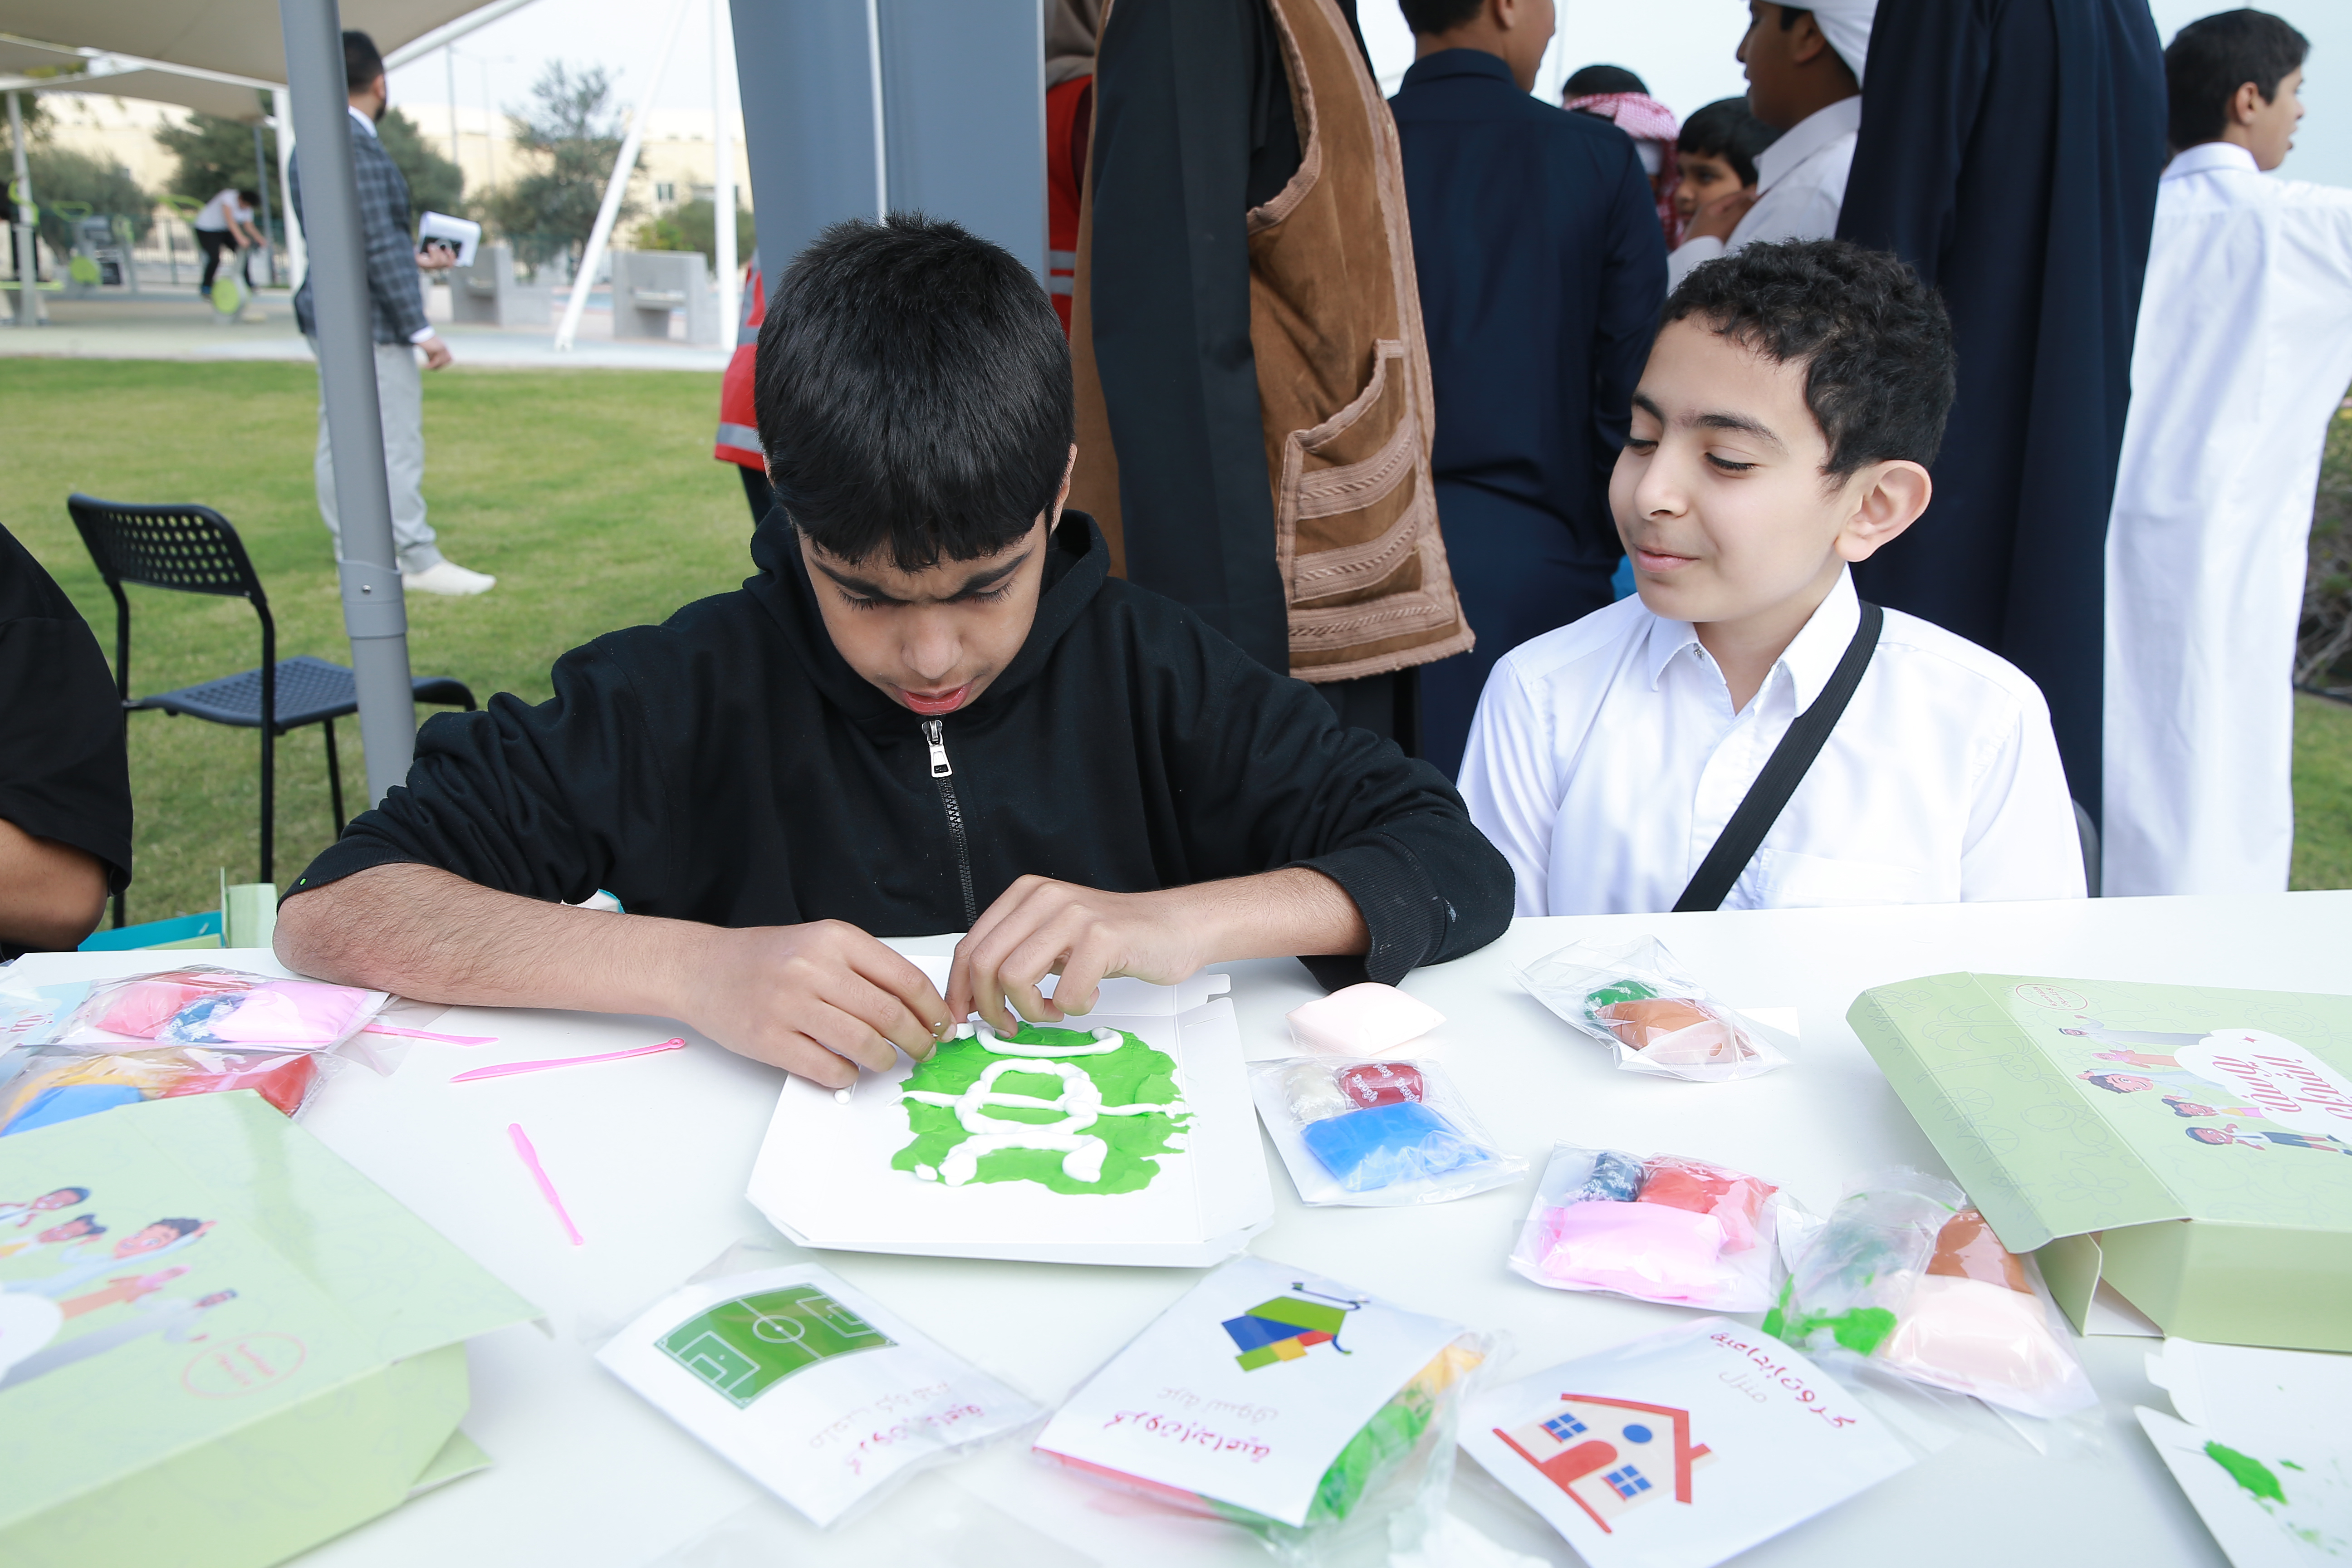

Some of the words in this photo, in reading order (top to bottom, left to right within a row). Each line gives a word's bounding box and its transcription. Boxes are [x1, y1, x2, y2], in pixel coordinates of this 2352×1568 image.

[182, 998, 211, 1015] Doug
[1352, 1073, 1378, 1102] Dough
[1781, 1377, 1857, 1428] كروت
